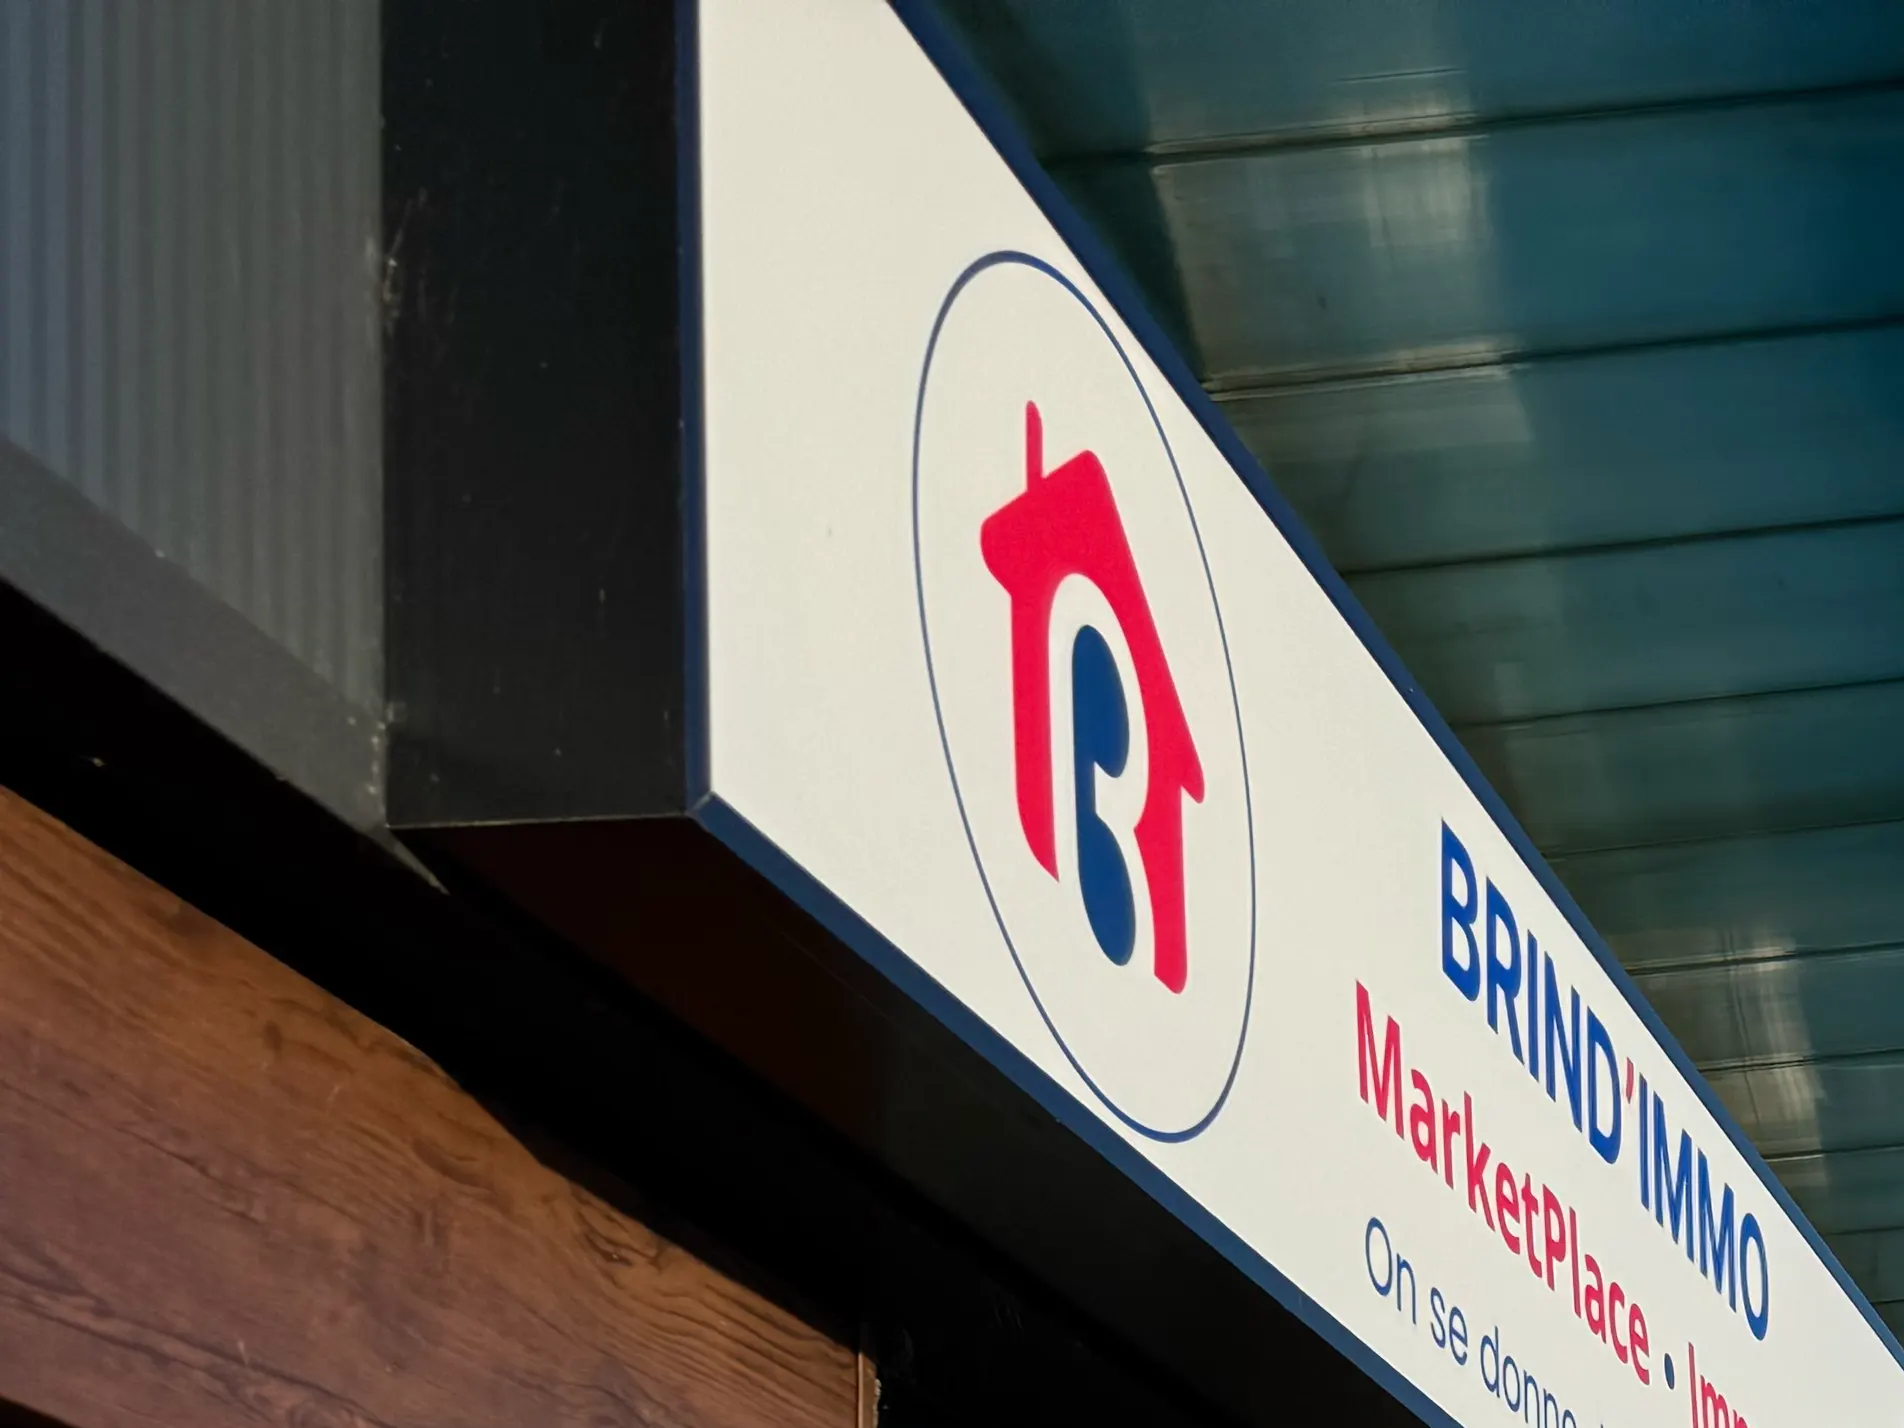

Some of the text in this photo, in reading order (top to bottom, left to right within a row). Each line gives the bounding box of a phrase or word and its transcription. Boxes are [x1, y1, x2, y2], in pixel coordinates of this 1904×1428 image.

[1356, 978, 1650, 1386] MarketPlace
[1441, 817, 1769, 1341] BRIND'IMMO
[1364, 1216, 1416, 1325] On
[1429, 1286, 1468, 1366] se
